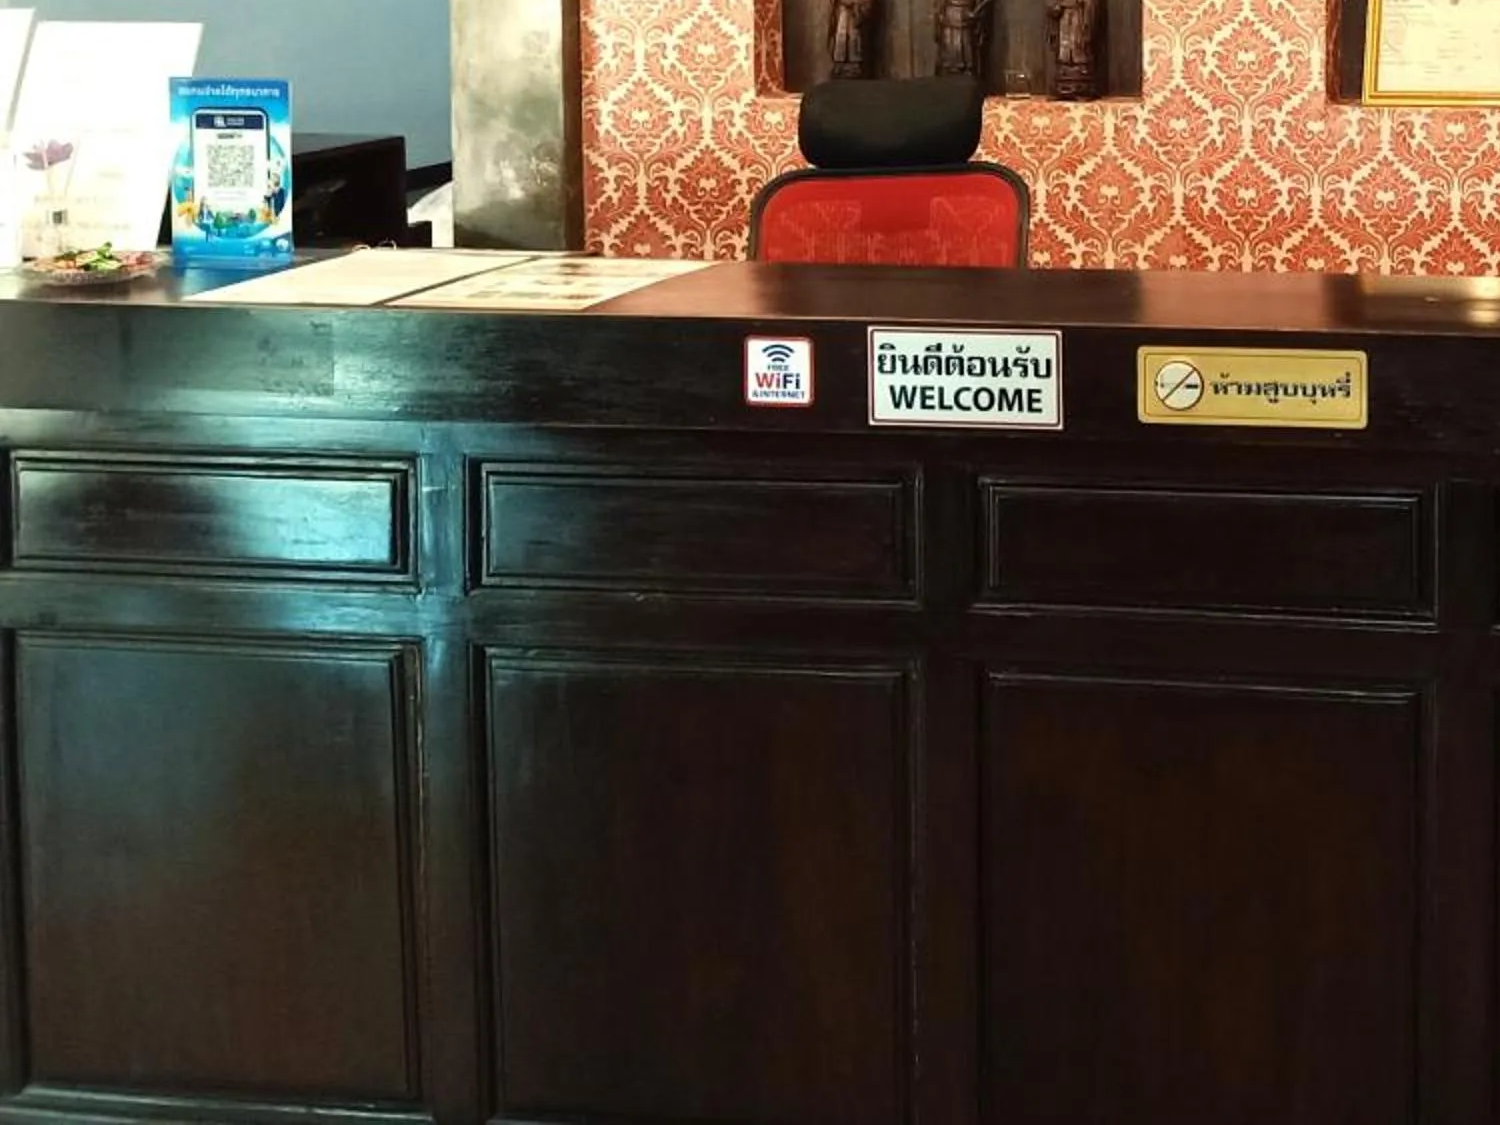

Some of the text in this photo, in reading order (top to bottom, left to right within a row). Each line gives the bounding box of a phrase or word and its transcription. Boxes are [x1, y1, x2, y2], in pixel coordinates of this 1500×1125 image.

[877, 342, 1053, 379] ยินดีต้อนรับ
[754, 372, 801, 390] WiFi
[1209, 371, 1352, 405] ห้ามสูบบุหรี่
[888, 384, 1044, 414] WELCOME
